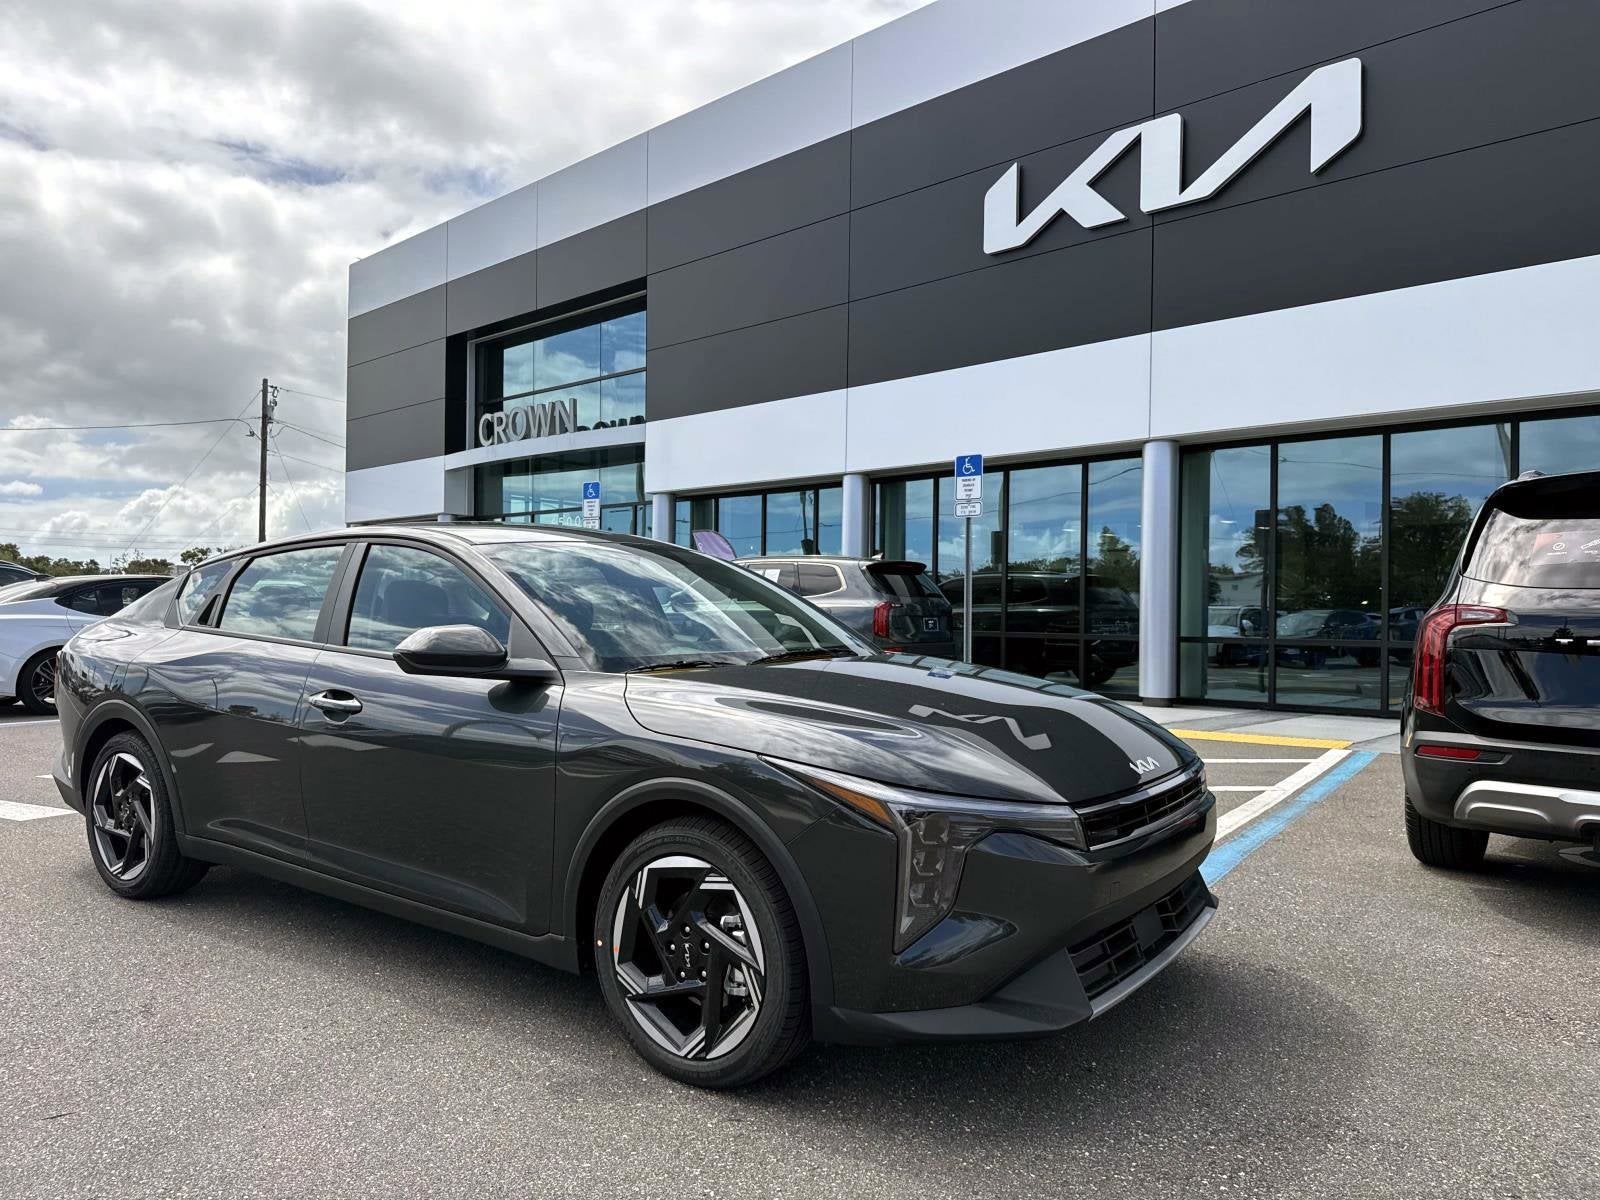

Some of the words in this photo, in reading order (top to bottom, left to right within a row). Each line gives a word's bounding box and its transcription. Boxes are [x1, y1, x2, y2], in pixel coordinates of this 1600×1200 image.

[984, 57, 1362, 255] KIA
[479, 398, 578, 447] CROWN
[1129, 756, 1161, 775] KIA
